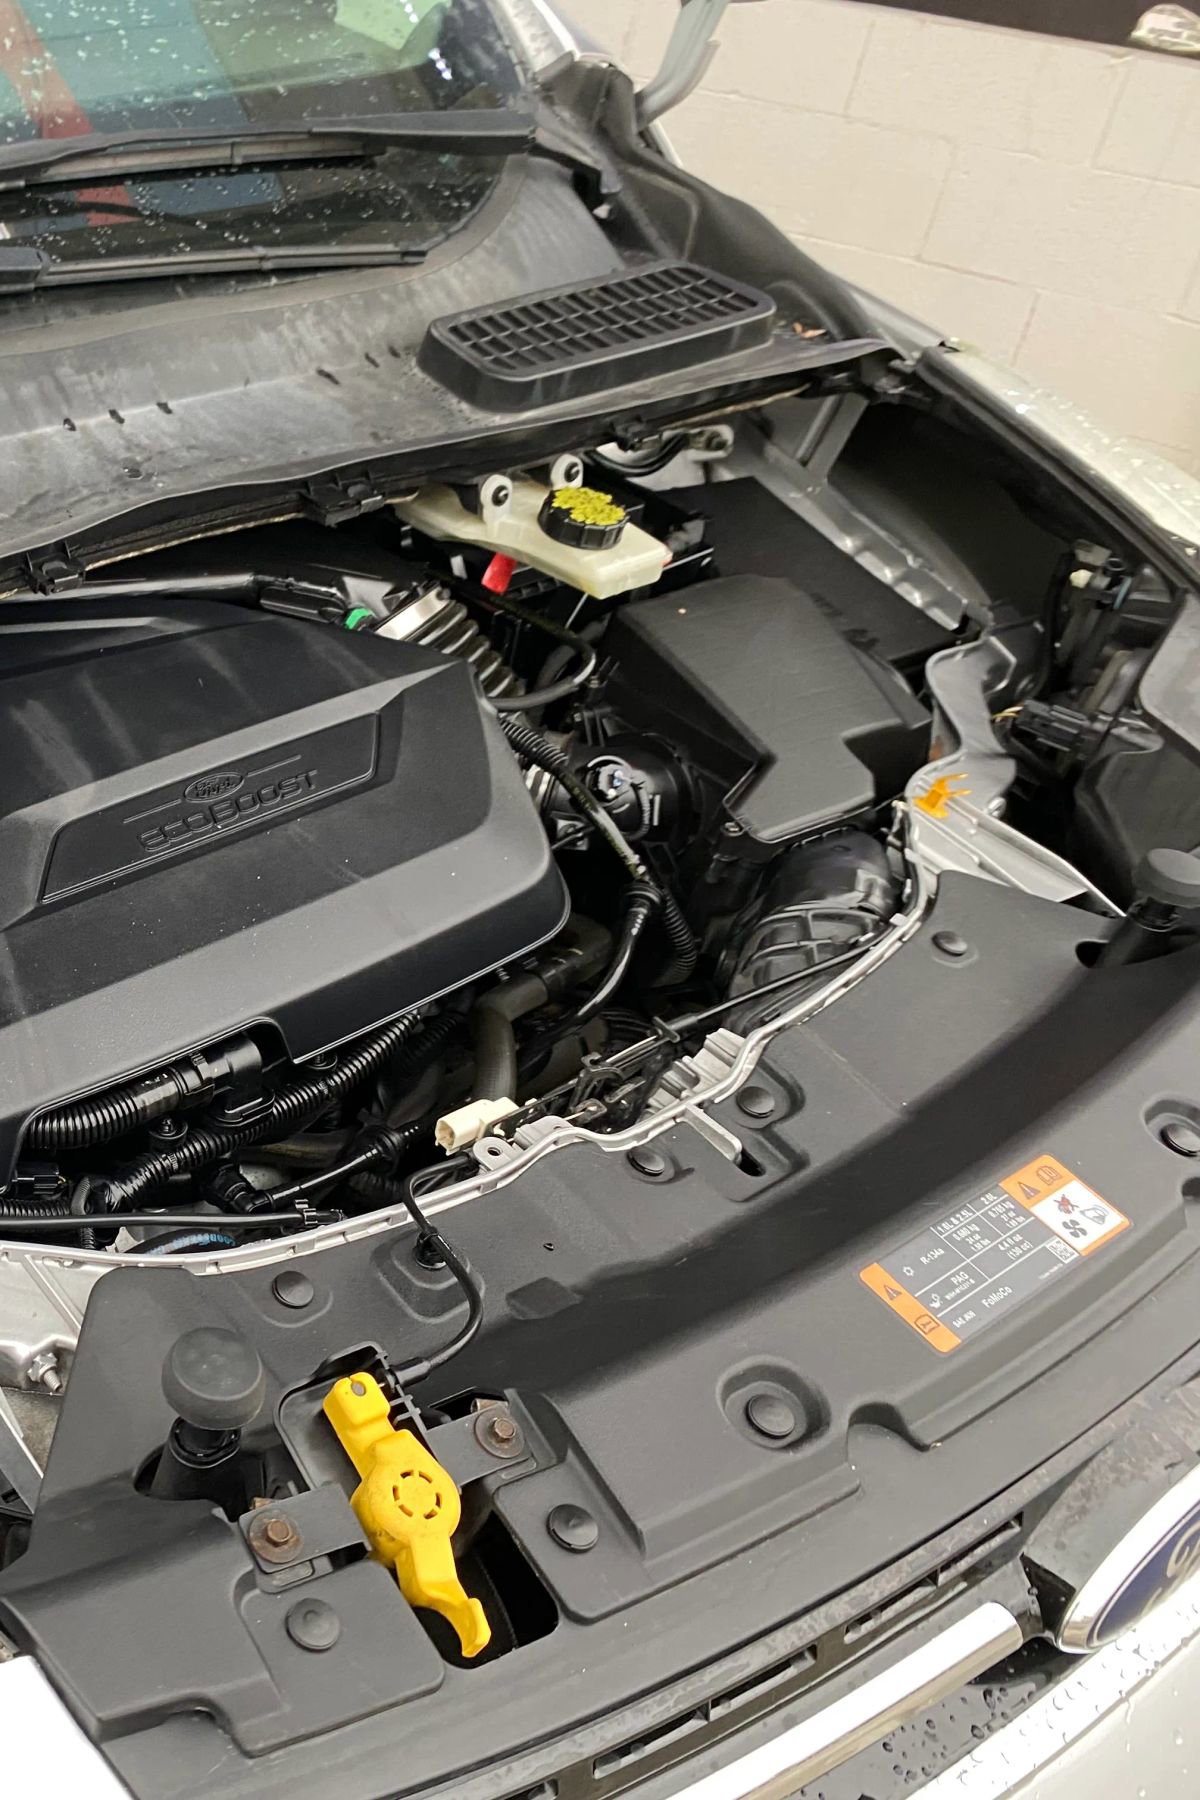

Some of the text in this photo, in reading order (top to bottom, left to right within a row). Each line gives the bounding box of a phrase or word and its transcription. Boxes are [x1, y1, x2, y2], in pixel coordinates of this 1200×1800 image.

[980, 1192, 998, 1205] 2.0L
[1002, 1200, 1015, 1209] kg
[936, 1208, 974, 1233] 1.6L & 2.5L
[966, 1223, 981, 1232] kg
[919, 1247, 945, 1265] R-134a
[950, 1270, 970, 1286] PAG
[981, 1285, 1013, 1309] FoMoCo
